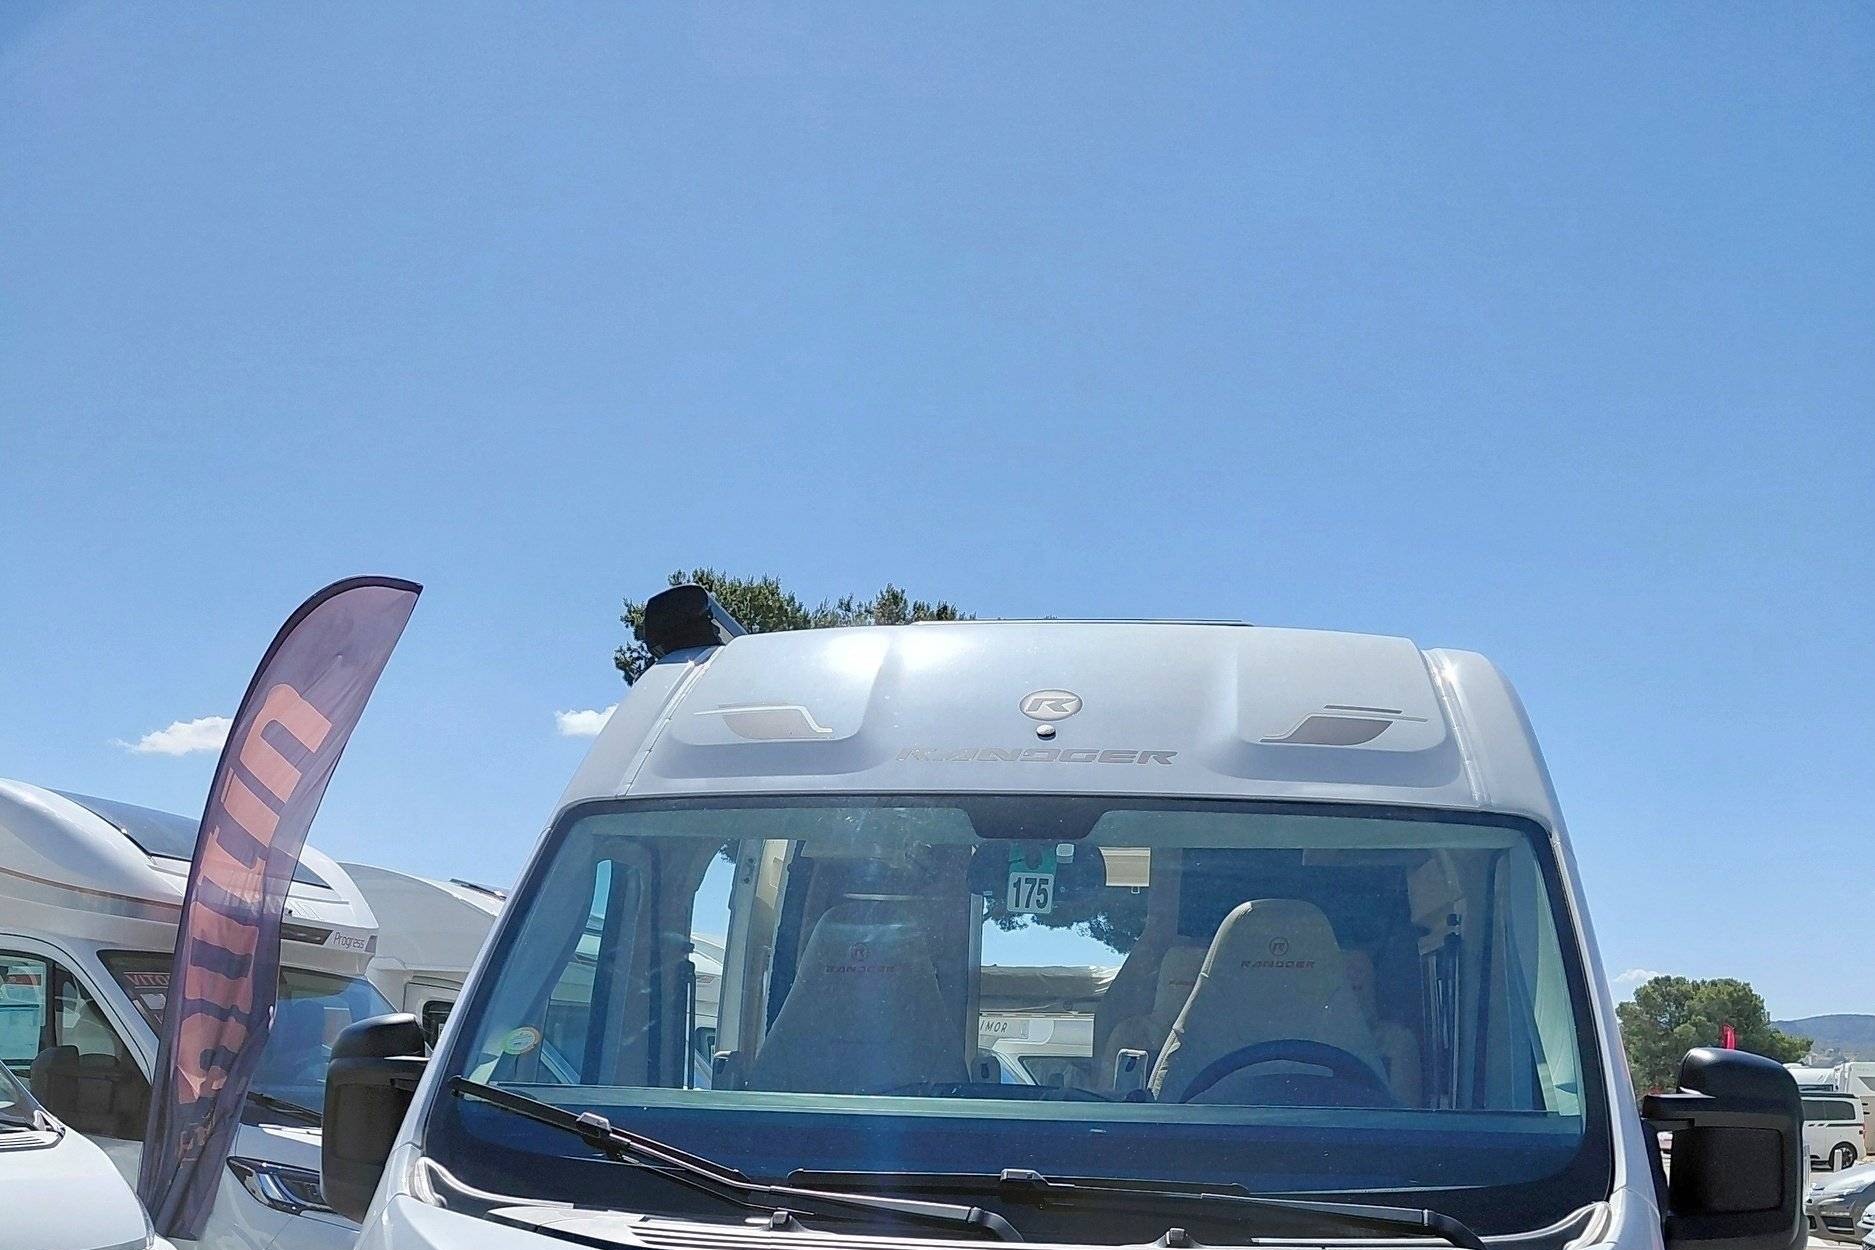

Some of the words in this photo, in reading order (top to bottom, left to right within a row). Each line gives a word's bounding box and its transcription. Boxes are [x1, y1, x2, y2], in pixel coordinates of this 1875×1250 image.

[1013, 877, 1050, 909] 175
[333, 931, 365, 949] Progress
[980, 1021, 1008, 1034] IMOR
